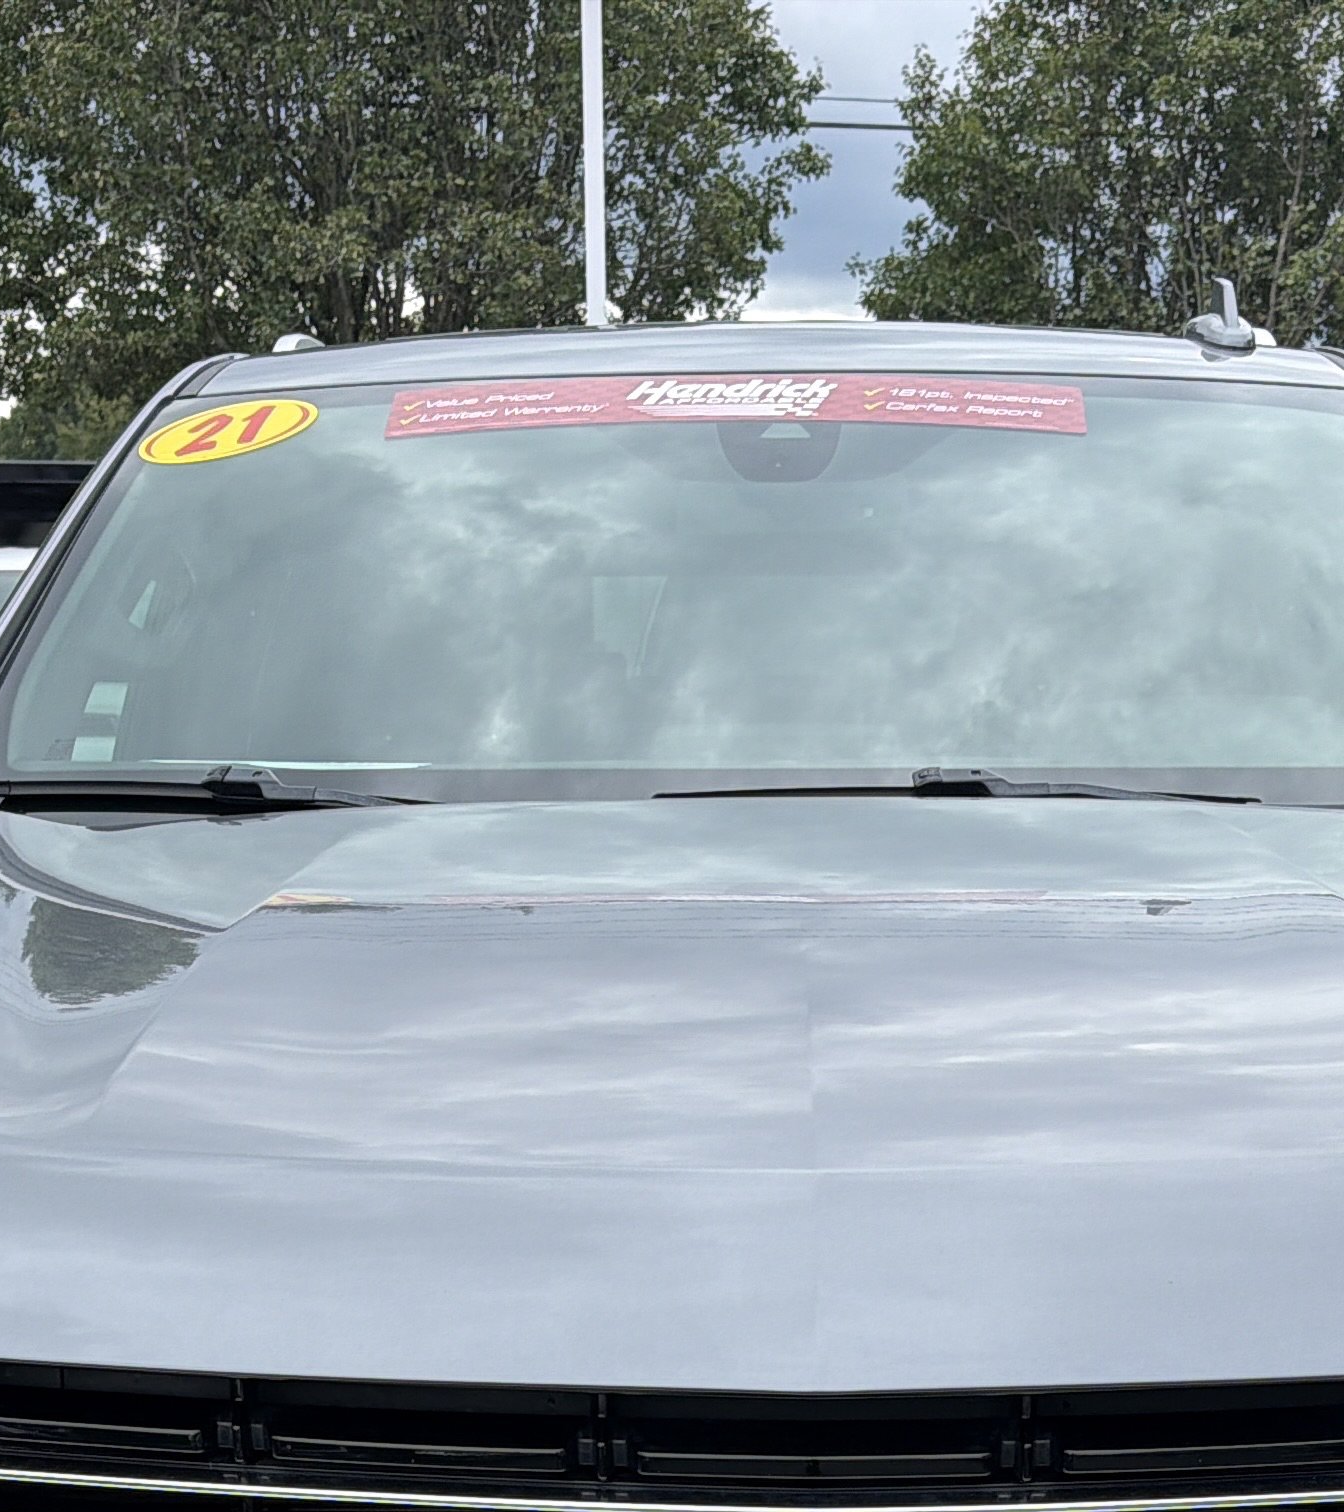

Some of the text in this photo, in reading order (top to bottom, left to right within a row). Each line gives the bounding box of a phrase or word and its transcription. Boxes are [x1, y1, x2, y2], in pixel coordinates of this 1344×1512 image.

[425, 392, 555, 409] Value Priced
[626, 379, 838, 405] Hendrick
[657, 397, 825, 405] AFFORDABLE
[885, 401, 1043, 418] Carfax Report
[419, 408, 498, 423] Limited
[174, 405, 277, 457] 21
